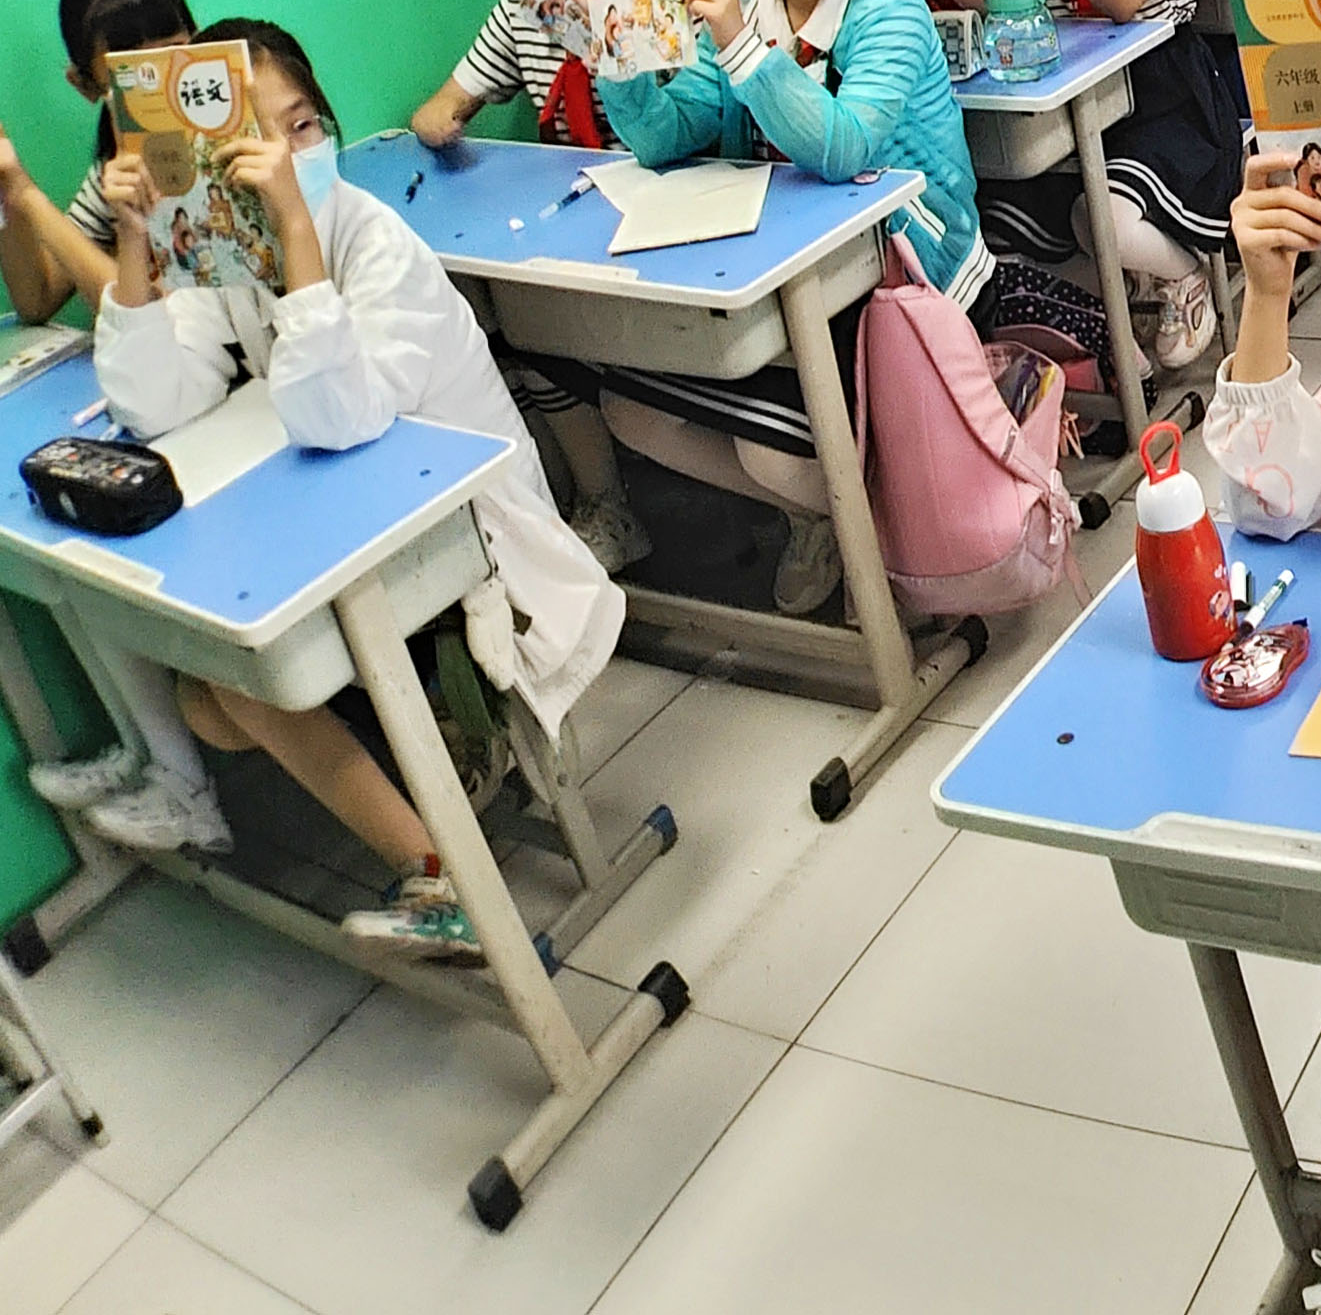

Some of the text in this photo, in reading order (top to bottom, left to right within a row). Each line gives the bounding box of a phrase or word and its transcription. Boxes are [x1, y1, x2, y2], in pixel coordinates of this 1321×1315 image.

[1275, 68, 1320, 86] 六年级
[180, 79, 230, 106] 语文
[1294, 100, 1314, 113] 上册
